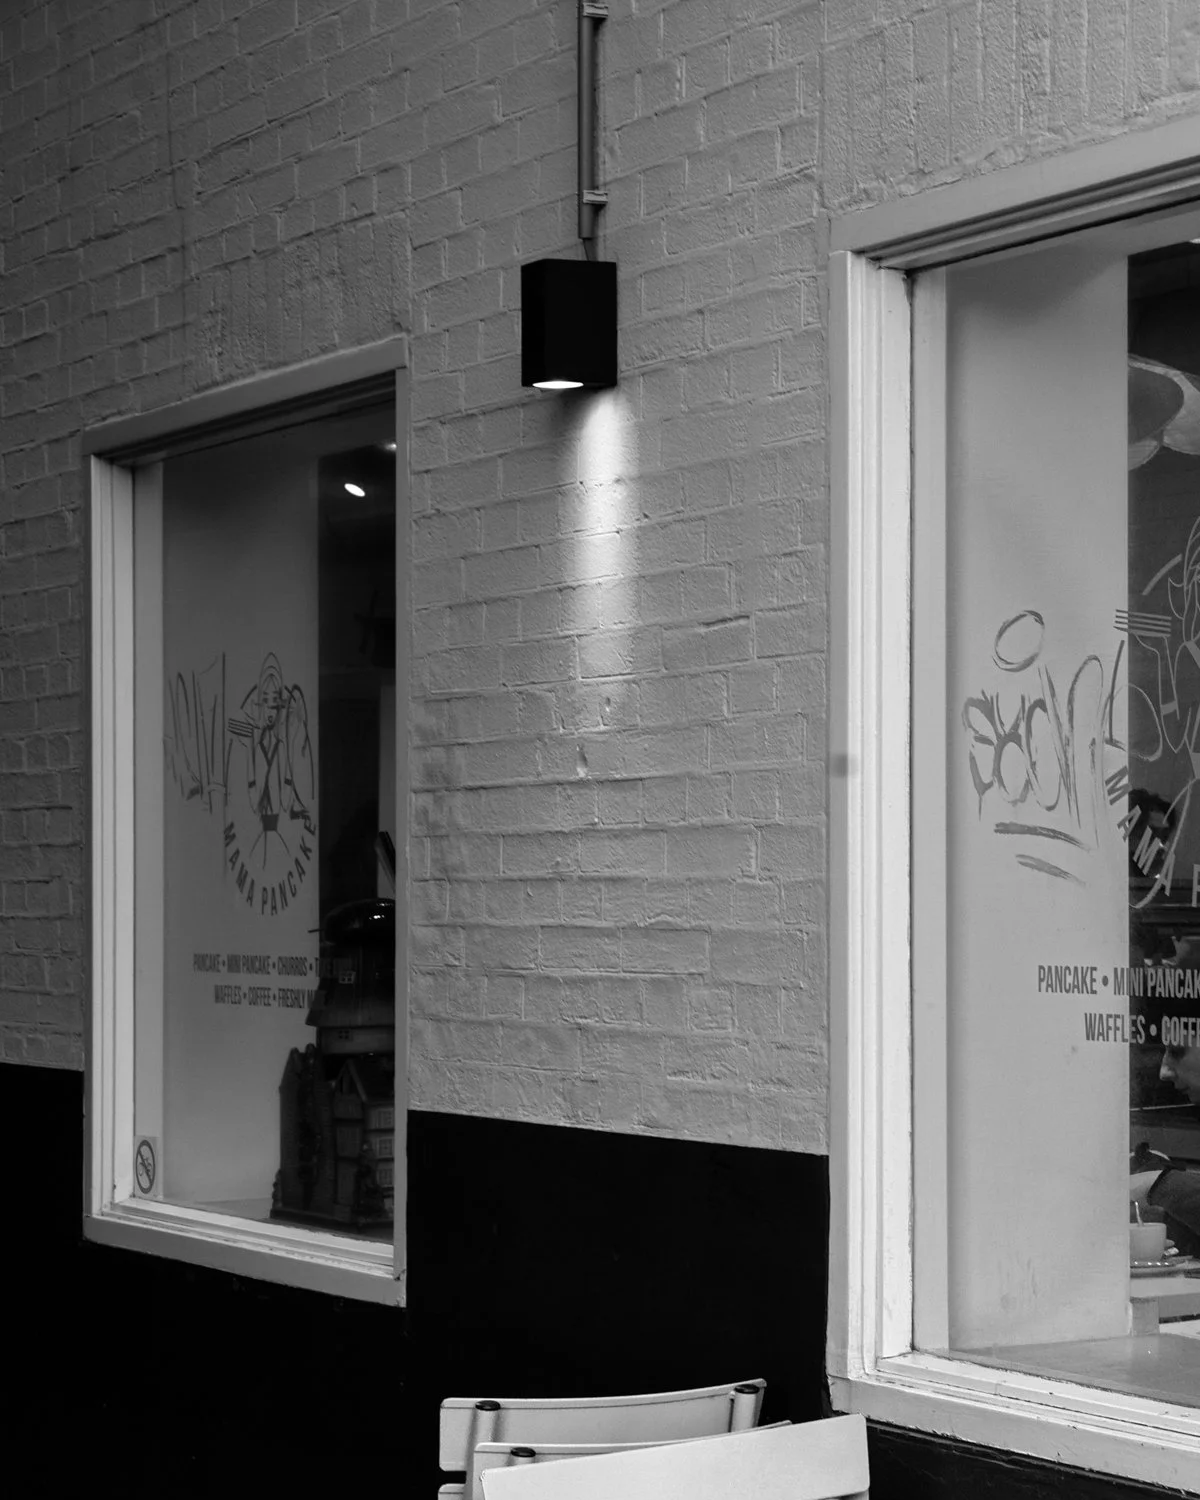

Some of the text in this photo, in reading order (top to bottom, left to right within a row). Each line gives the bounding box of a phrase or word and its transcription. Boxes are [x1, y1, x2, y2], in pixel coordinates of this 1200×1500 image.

[1104, 765, 1176, 897] MAMA
[223, 813, 317, 916] MAMA PANCAKE
[193, 953, 221, 973] PANCAKE
[241, 955, 271, 976] PANCAKE
[277, 956, 308, 977] CHURROS
[1037, 965, 1098, 995] PANCAKE
[1113, 967, 1144, 997] MINI
[214, 984, 242, 1005] WAFFLES
[248, 986, 272, 1007] COFFEE
[277, 988, 306, 1009] FRESHLY
[1084, 1012, 1146, 1044] WAFFLES
